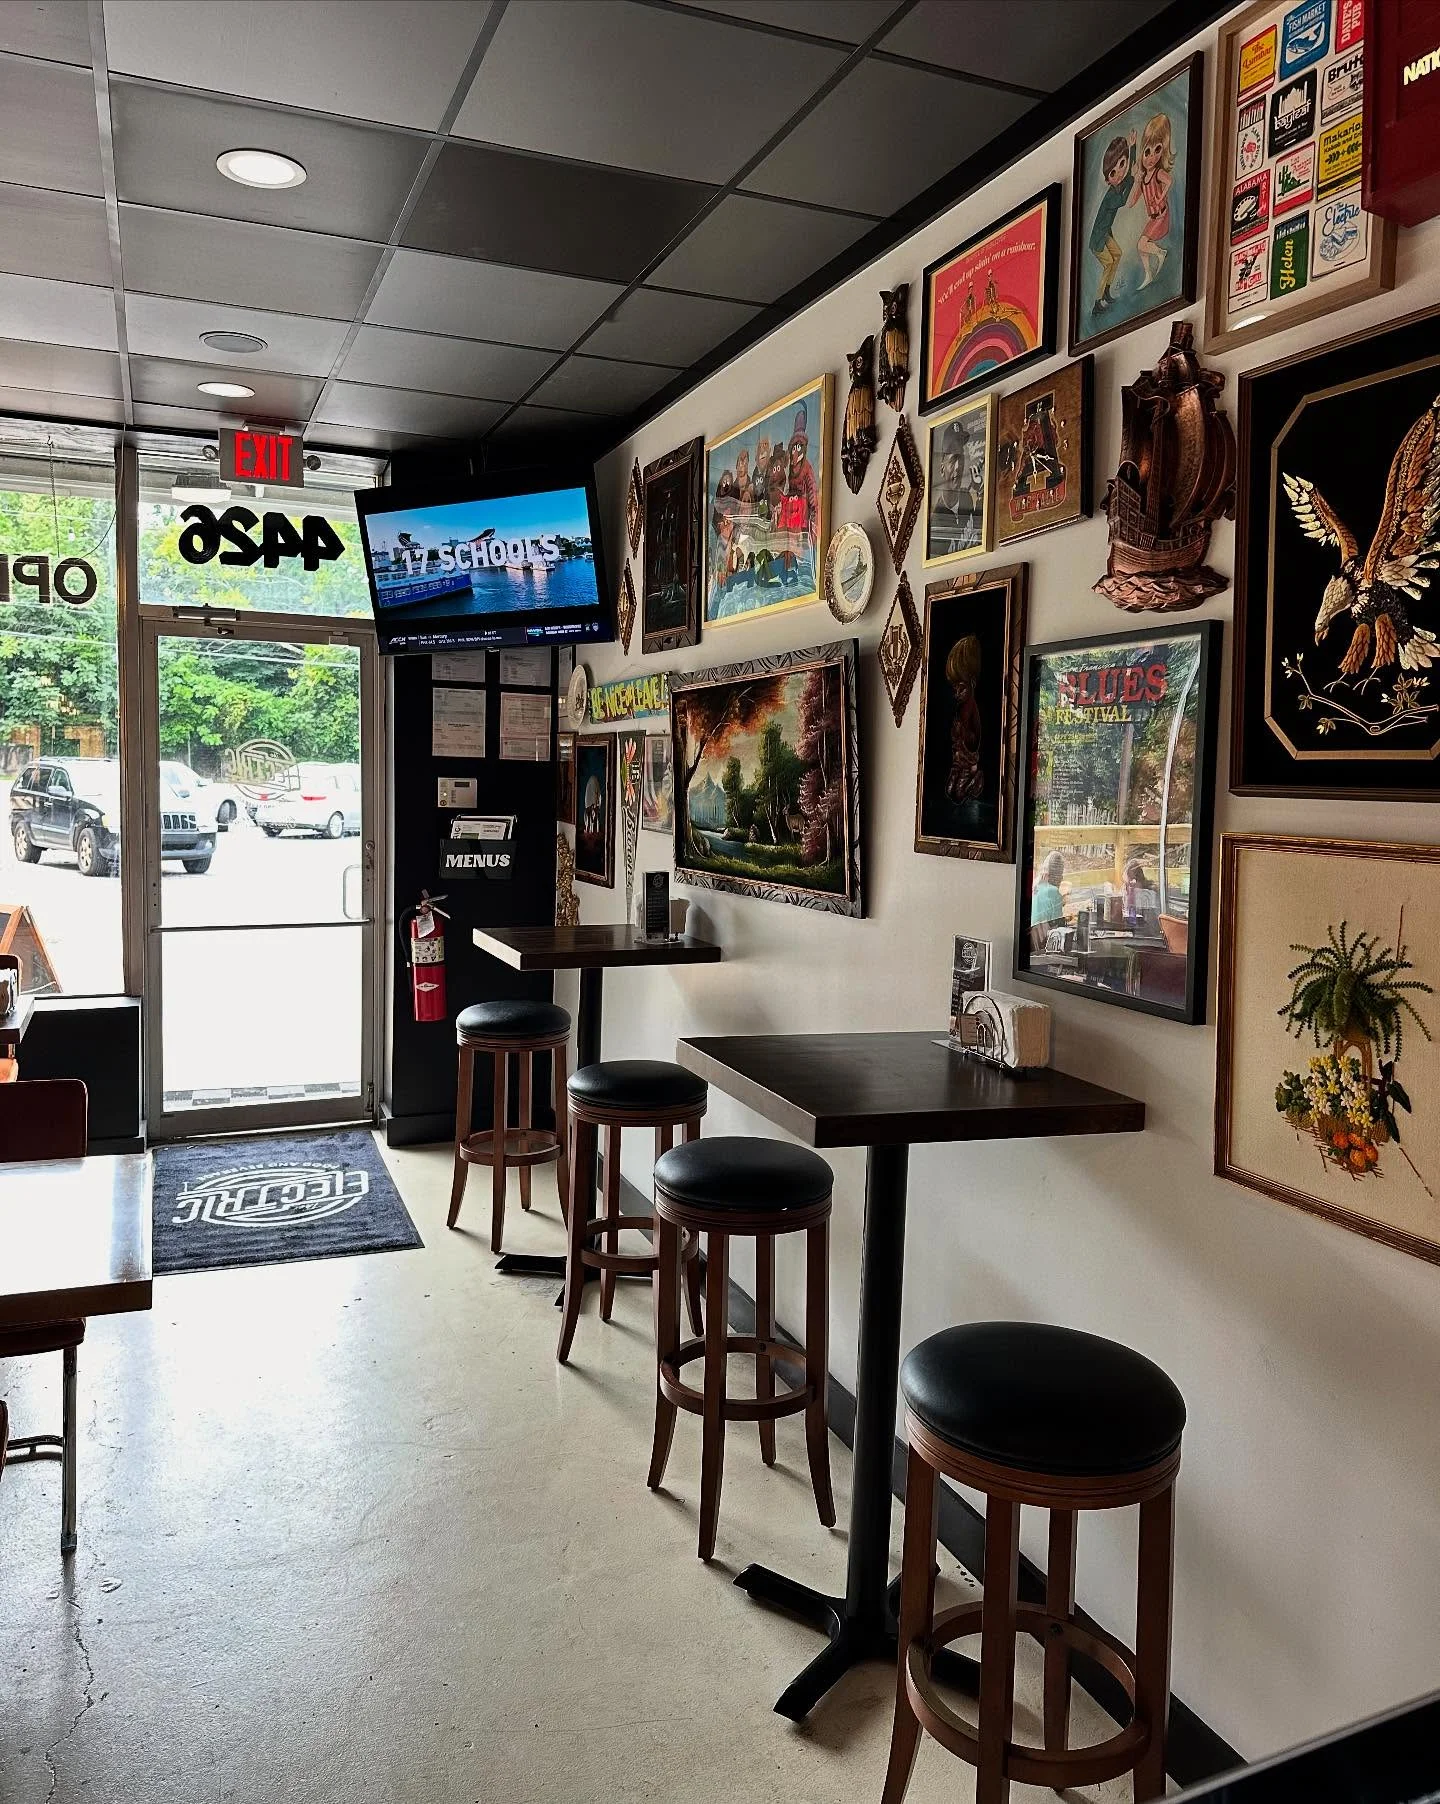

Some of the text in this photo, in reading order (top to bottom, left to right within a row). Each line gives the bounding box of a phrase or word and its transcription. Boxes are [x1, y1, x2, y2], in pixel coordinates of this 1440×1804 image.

[1289, 17, 1301, 32] FISH
[1302, 1, 1326, 24] MARKET
[1352, 2, 1361, 29] PUB
[1235, 174, 1267, 195] ALABAMA
[1322, 204, 1360, 236] Electric
[1279, 239, 1296, 289] Helen
[235, 432, 293, 481] EXIT
[402, 534, 559, 574] 17 SCHOOLS
[1057, 663, 1168, 706] BLUES
[591, 687, 605, 719] BE
[1055, 705, 1132, 725] FESTIVAL
[445, 854, 511, 868] MENUS
[172, 1171, 369, 1223] ELECTRIC
